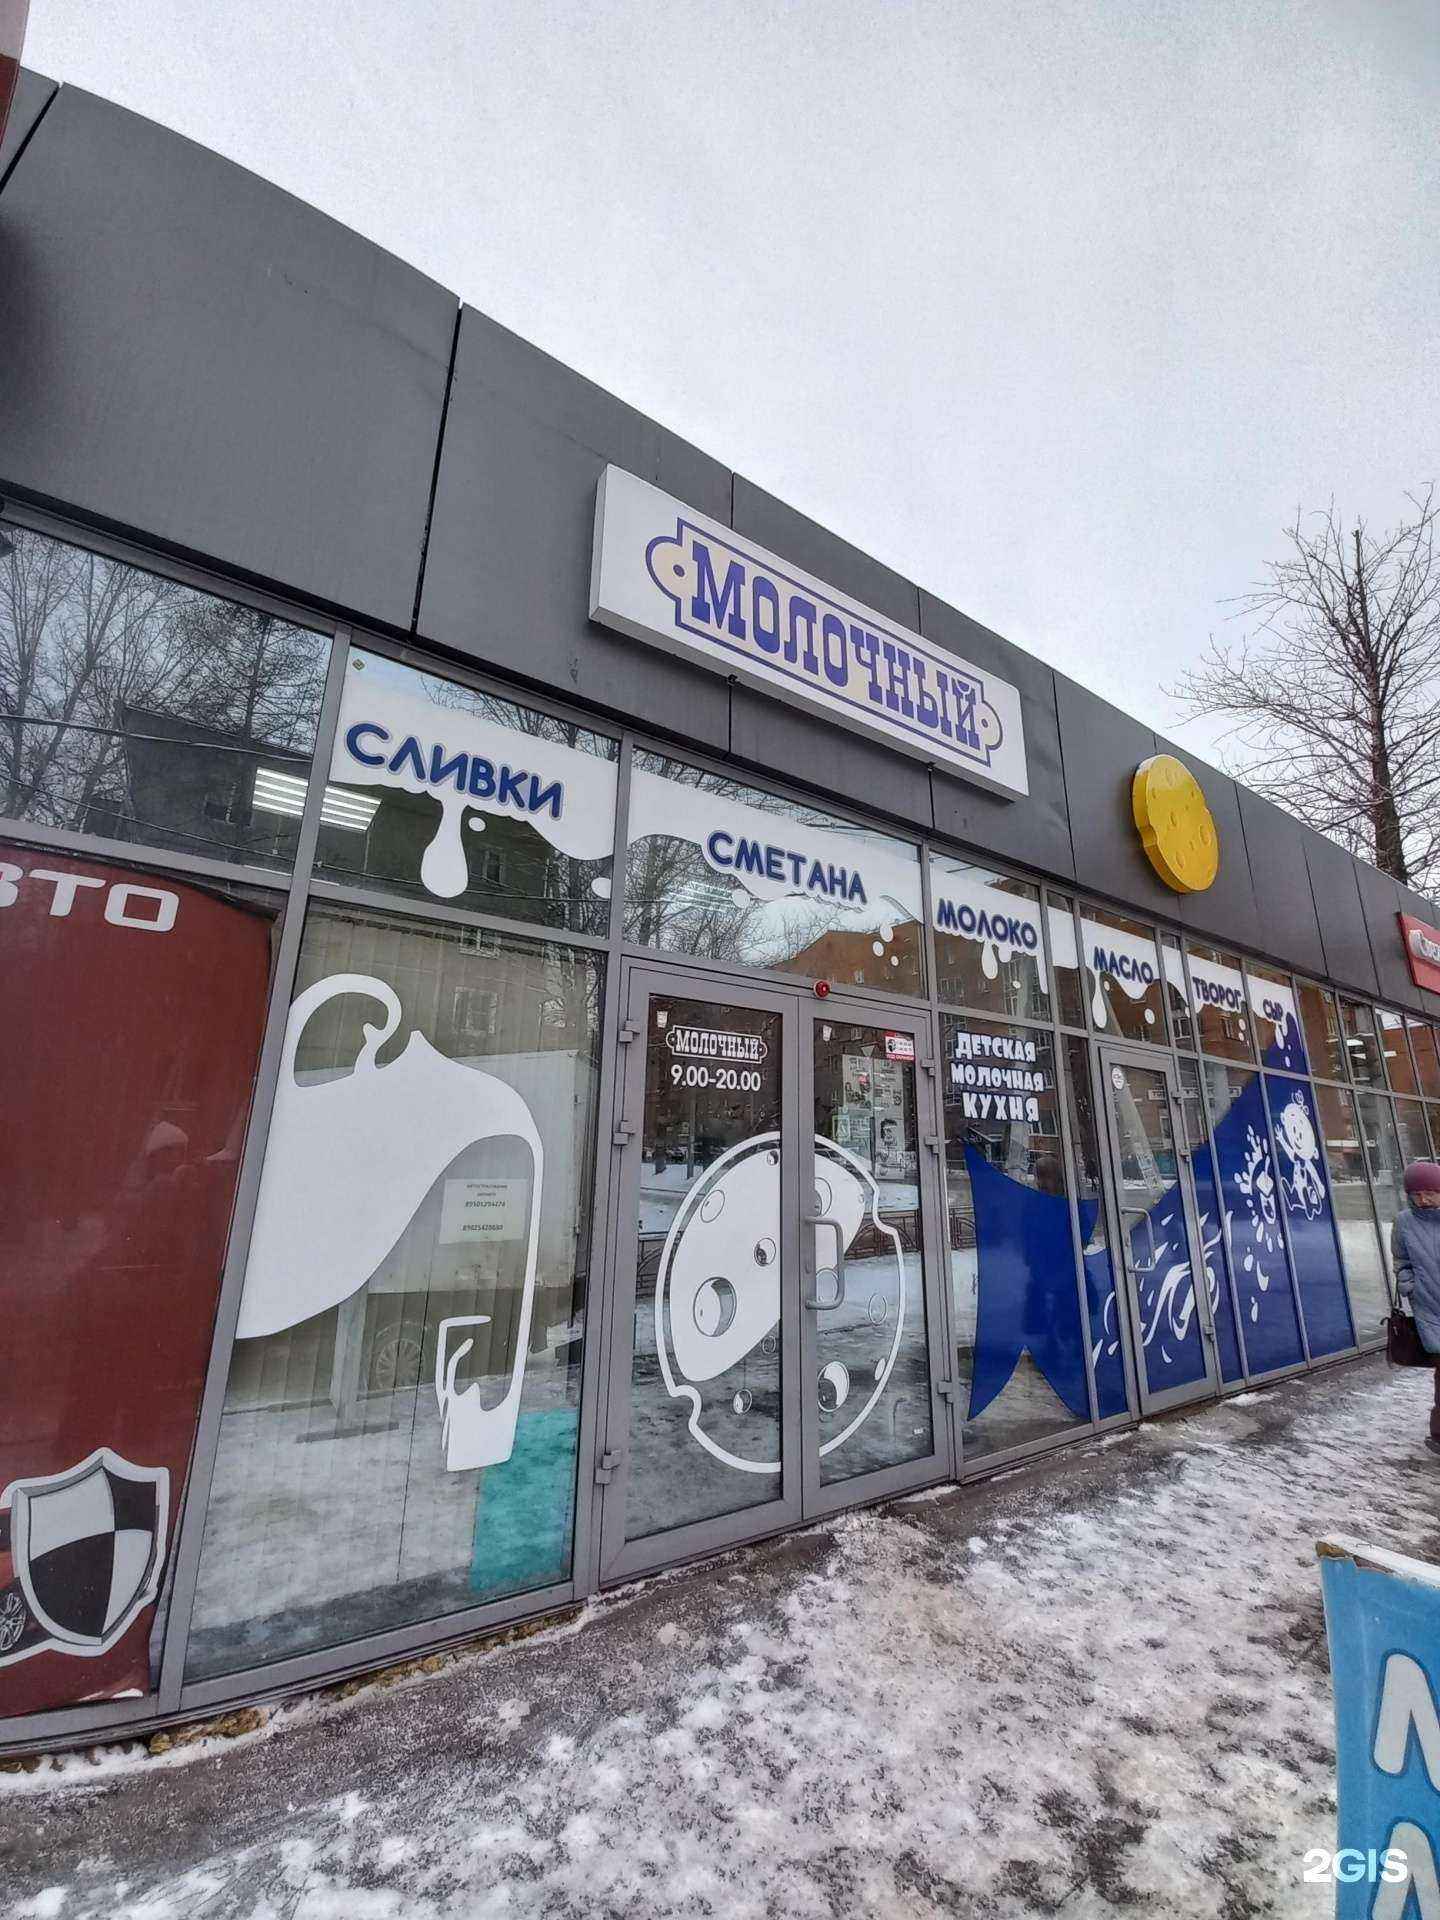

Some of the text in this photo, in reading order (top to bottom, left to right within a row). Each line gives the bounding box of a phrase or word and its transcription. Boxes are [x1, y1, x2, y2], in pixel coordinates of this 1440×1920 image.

[691, 538, 981, 752] МОЛОЧНЫЙ
[345, 721, 564, 819] СЛИВКИ
[707, 830, 868, 903] СМЕТАНА
[936, 898, 1039, 950] МОЛОКО
[1093, 945, 1155, 985] МАСЛО
[1192, 976, 1242, 1010] ТВОРОГ
[1262, 999, 1284, 1022] СЫР
[675, 1029, 760, 1060] МОЛОЧНЫЙ
[955, 1031, 1037, 1063] ДЕТСКАЯ
[670, 1064, 762, 1092] 9.00-20.00
[950, 1062, 1045, 1092] МОЛОЧНАЯ
[961, 1091, 1041, 1123] КУХНЯ
